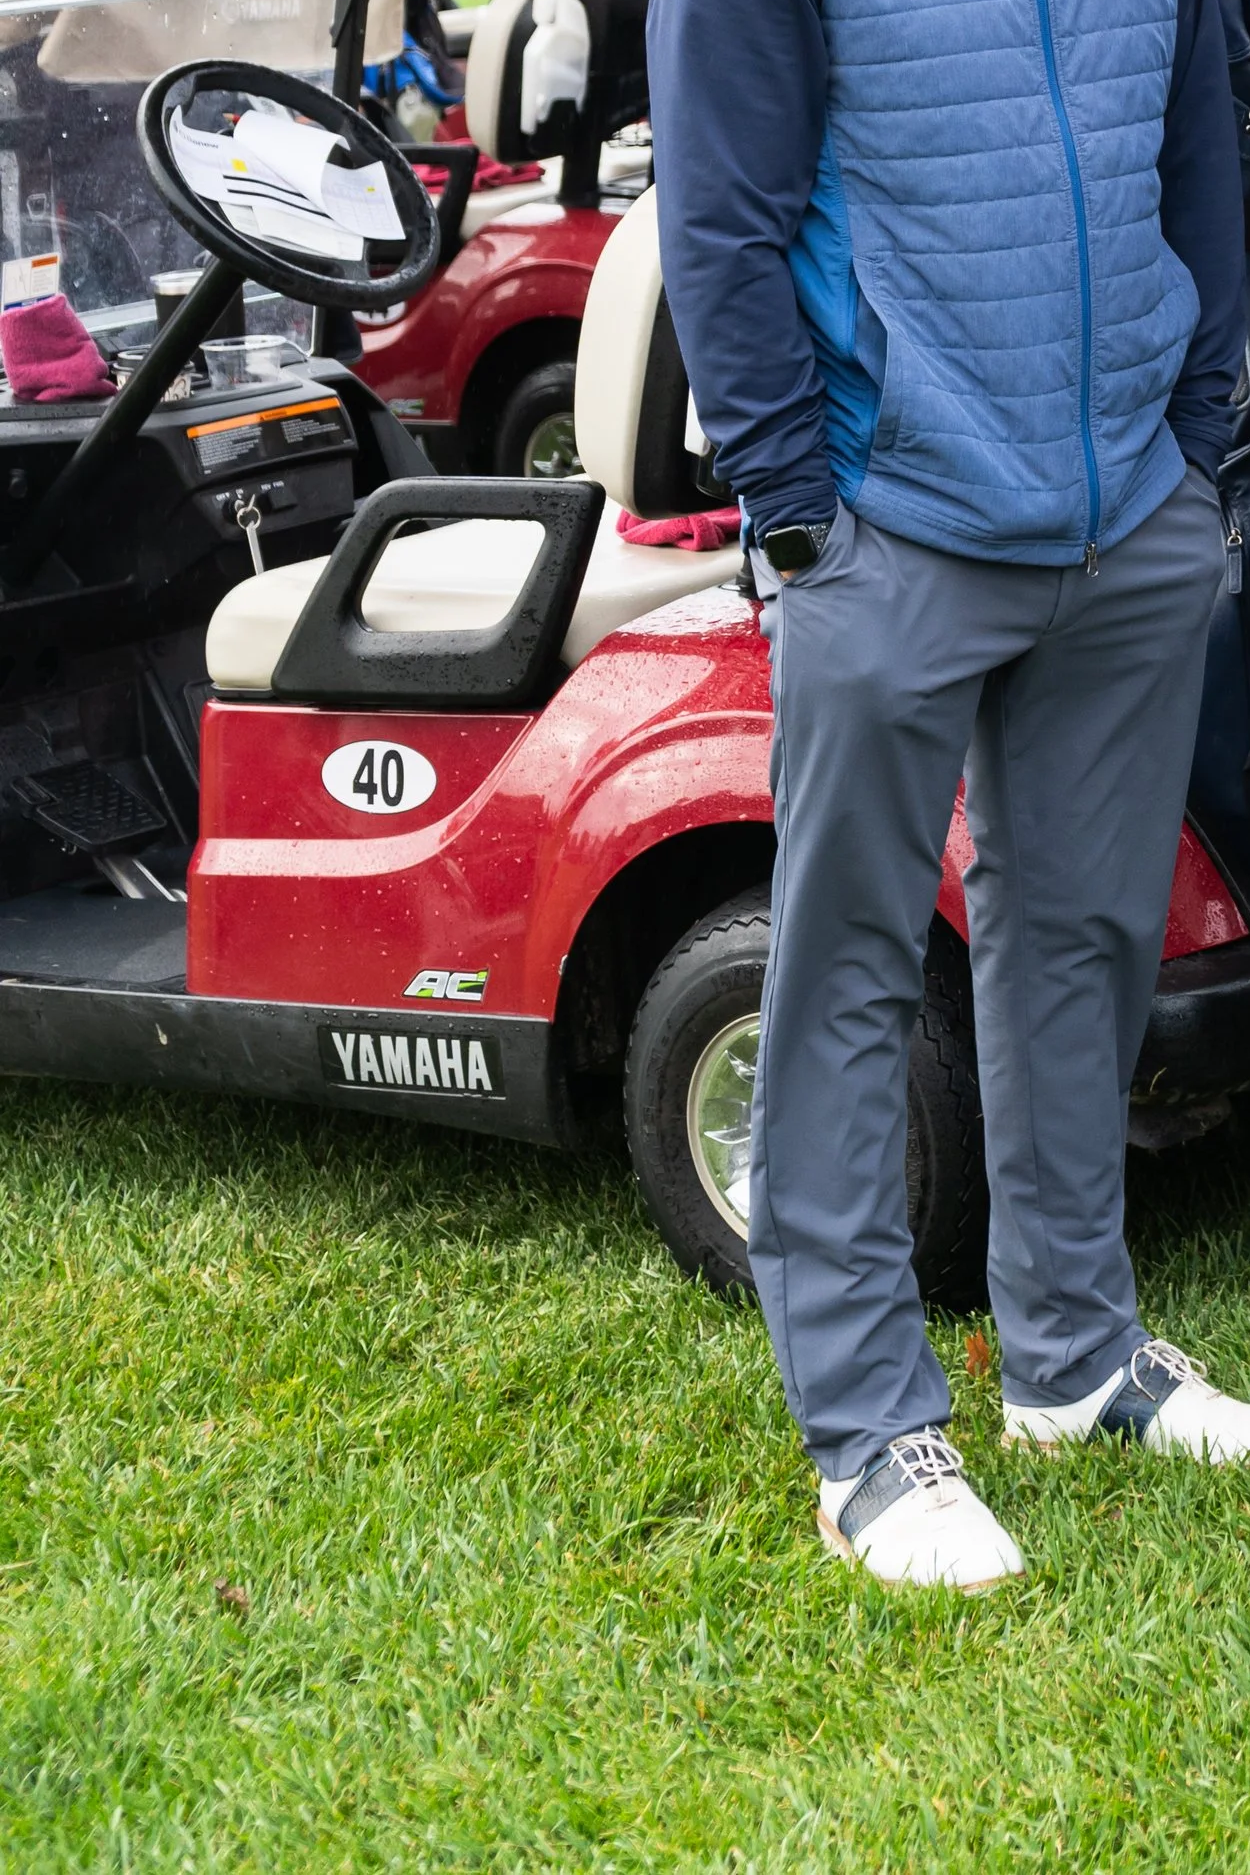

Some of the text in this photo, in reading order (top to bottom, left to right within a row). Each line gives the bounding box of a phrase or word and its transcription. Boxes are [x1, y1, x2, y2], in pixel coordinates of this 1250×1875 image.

[353, 747, 404, 807] 40
[403, 970, 489, 1002] AC
[331, 1031, 494, 1092] YAMAHA
